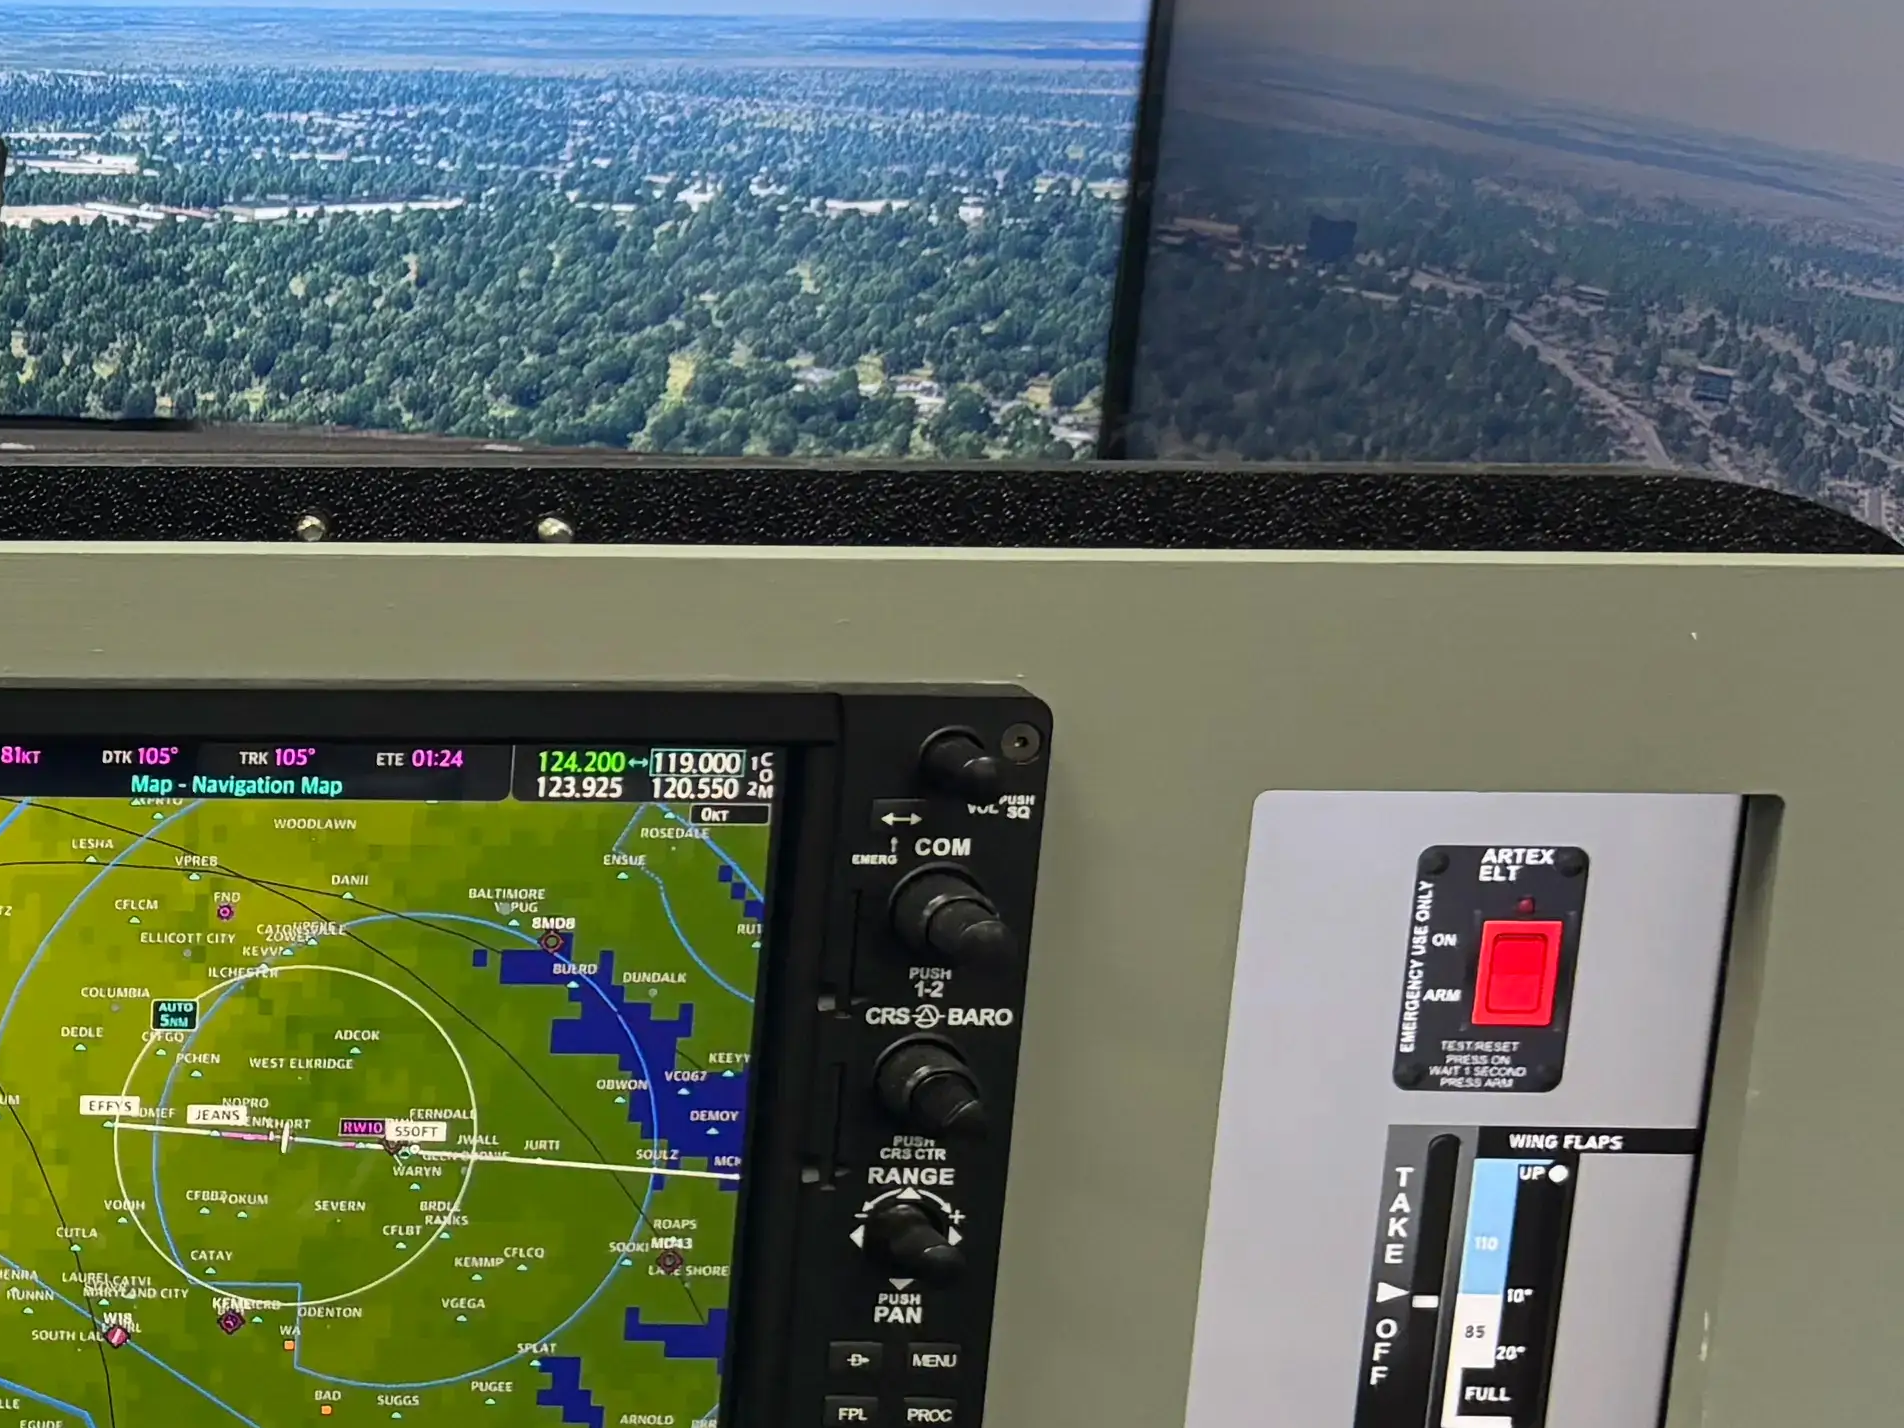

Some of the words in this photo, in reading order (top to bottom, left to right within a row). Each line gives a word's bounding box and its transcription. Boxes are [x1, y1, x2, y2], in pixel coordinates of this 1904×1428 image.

[103, 749, 132, 764] DTK
[240, 751, 269, 765] TRK
[377, 752, 404, 766] ETE
[412, 749, 463, 767] 01:24
[538, 751, 625, 772] 124.200
[654, 753, 740, 773] 119.000
[131, 776, 172, 795] Map
[192, 776, 296, 796] Navigation
[301, 777, 342, 796] Map
[274, 819, 357, 830] WOODLAWN
[915, 838, 971, 856] COM
[1482, 848, 1554, 865] ARTEX
[1479, 865, 1519, 882] ELT
[468, 888, 545, 899] BALTIMORE
[1432, 933, 1456, 947] ON
[623, 972, 686, 983] DUNDALK
[335, 1030, 380, 1041] ADCOK
[249, 1058, 286, 1068] WEST
[290, 1058, 353, 1069] ELKRIDGE
[195, 1109, 240, 1121] JEANS
[343, 1122, 382, 1134] RW10
[1509, 1134, 1558, 1148] WING
[1563, 1134, 1622, 1150] FLAPS
[869, 1168, 954, 1185] RANGE
[1520, 1166, 1545, 1180] UP
[315, 1200, 365, 1212] SEVERN
[1465, 1387, 1510, 1401] FULL
